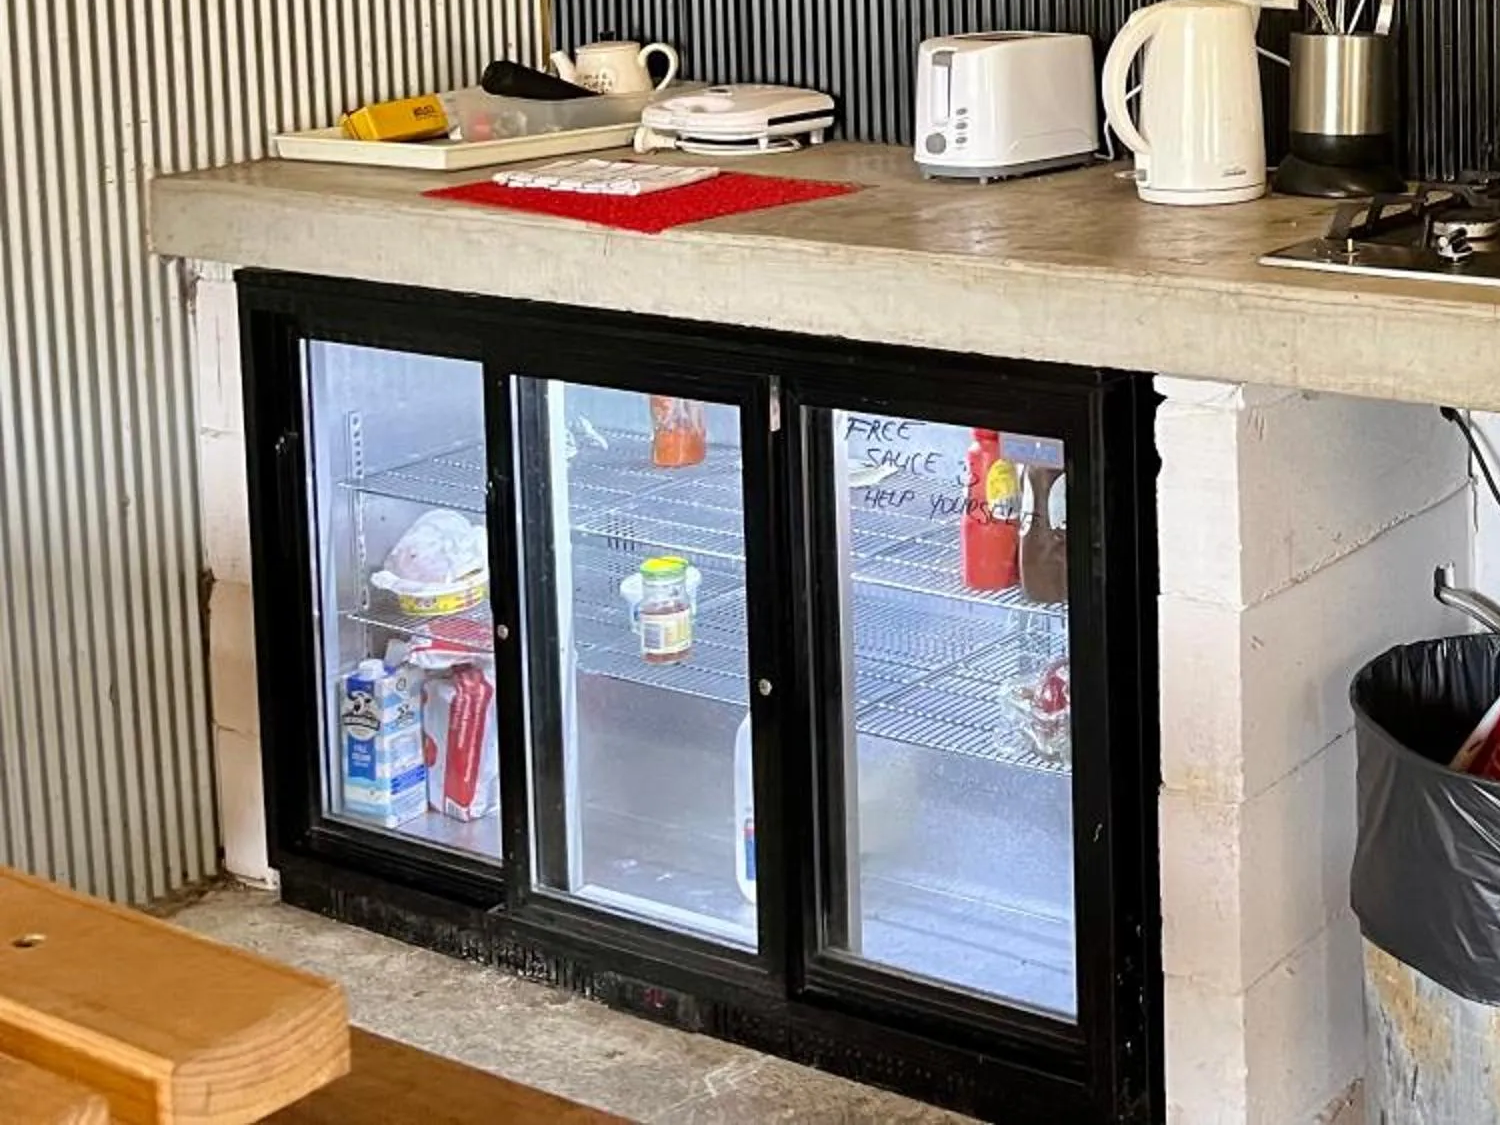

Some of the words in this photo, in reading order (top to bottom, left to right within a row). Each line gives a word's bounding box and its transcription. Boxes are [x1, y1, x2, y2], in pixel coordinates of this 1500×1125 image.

[844, 417, 926, 442] FREE
[861, 449, 943, 476] SAUCE
[865, 489, 915, 508] HELP
